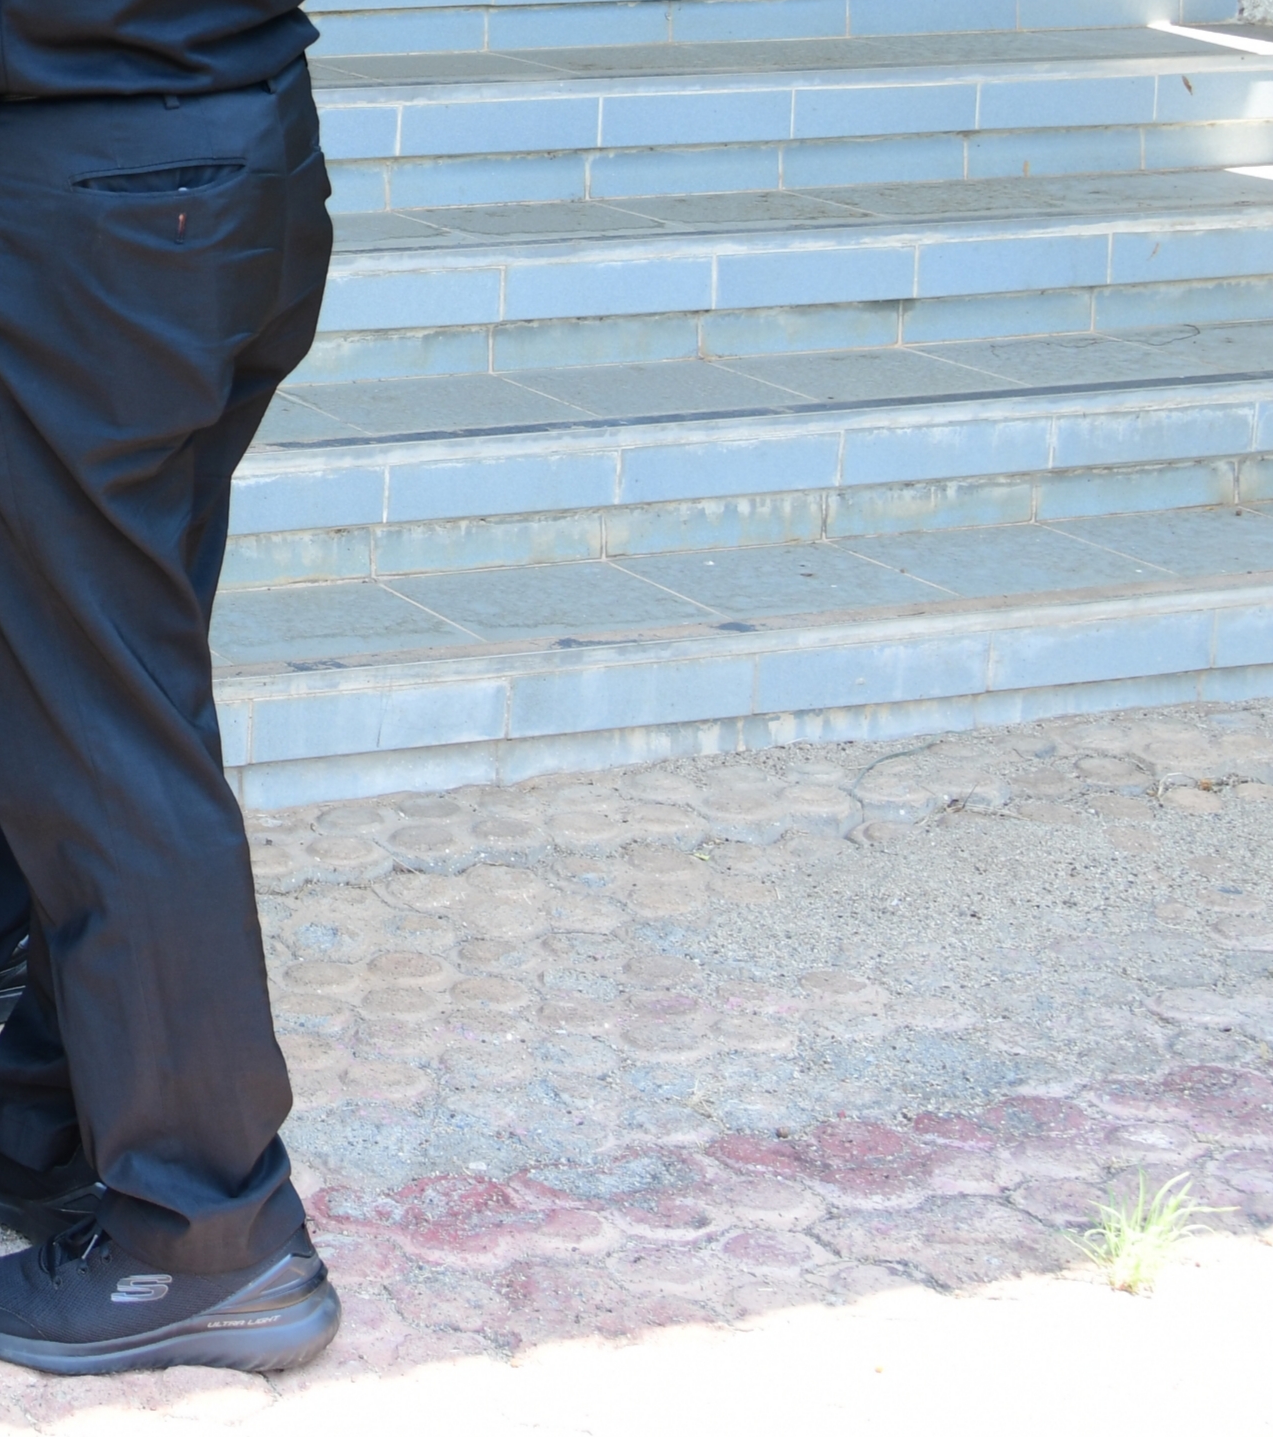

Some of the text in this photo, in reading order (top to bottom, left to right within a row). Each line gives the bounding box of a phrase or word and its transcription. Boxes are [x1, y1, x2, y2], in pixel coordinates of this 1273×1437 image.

[110, 1274, 173, 1303] S
[207, 1314, 282, 1328] ULTRA LIGHT
